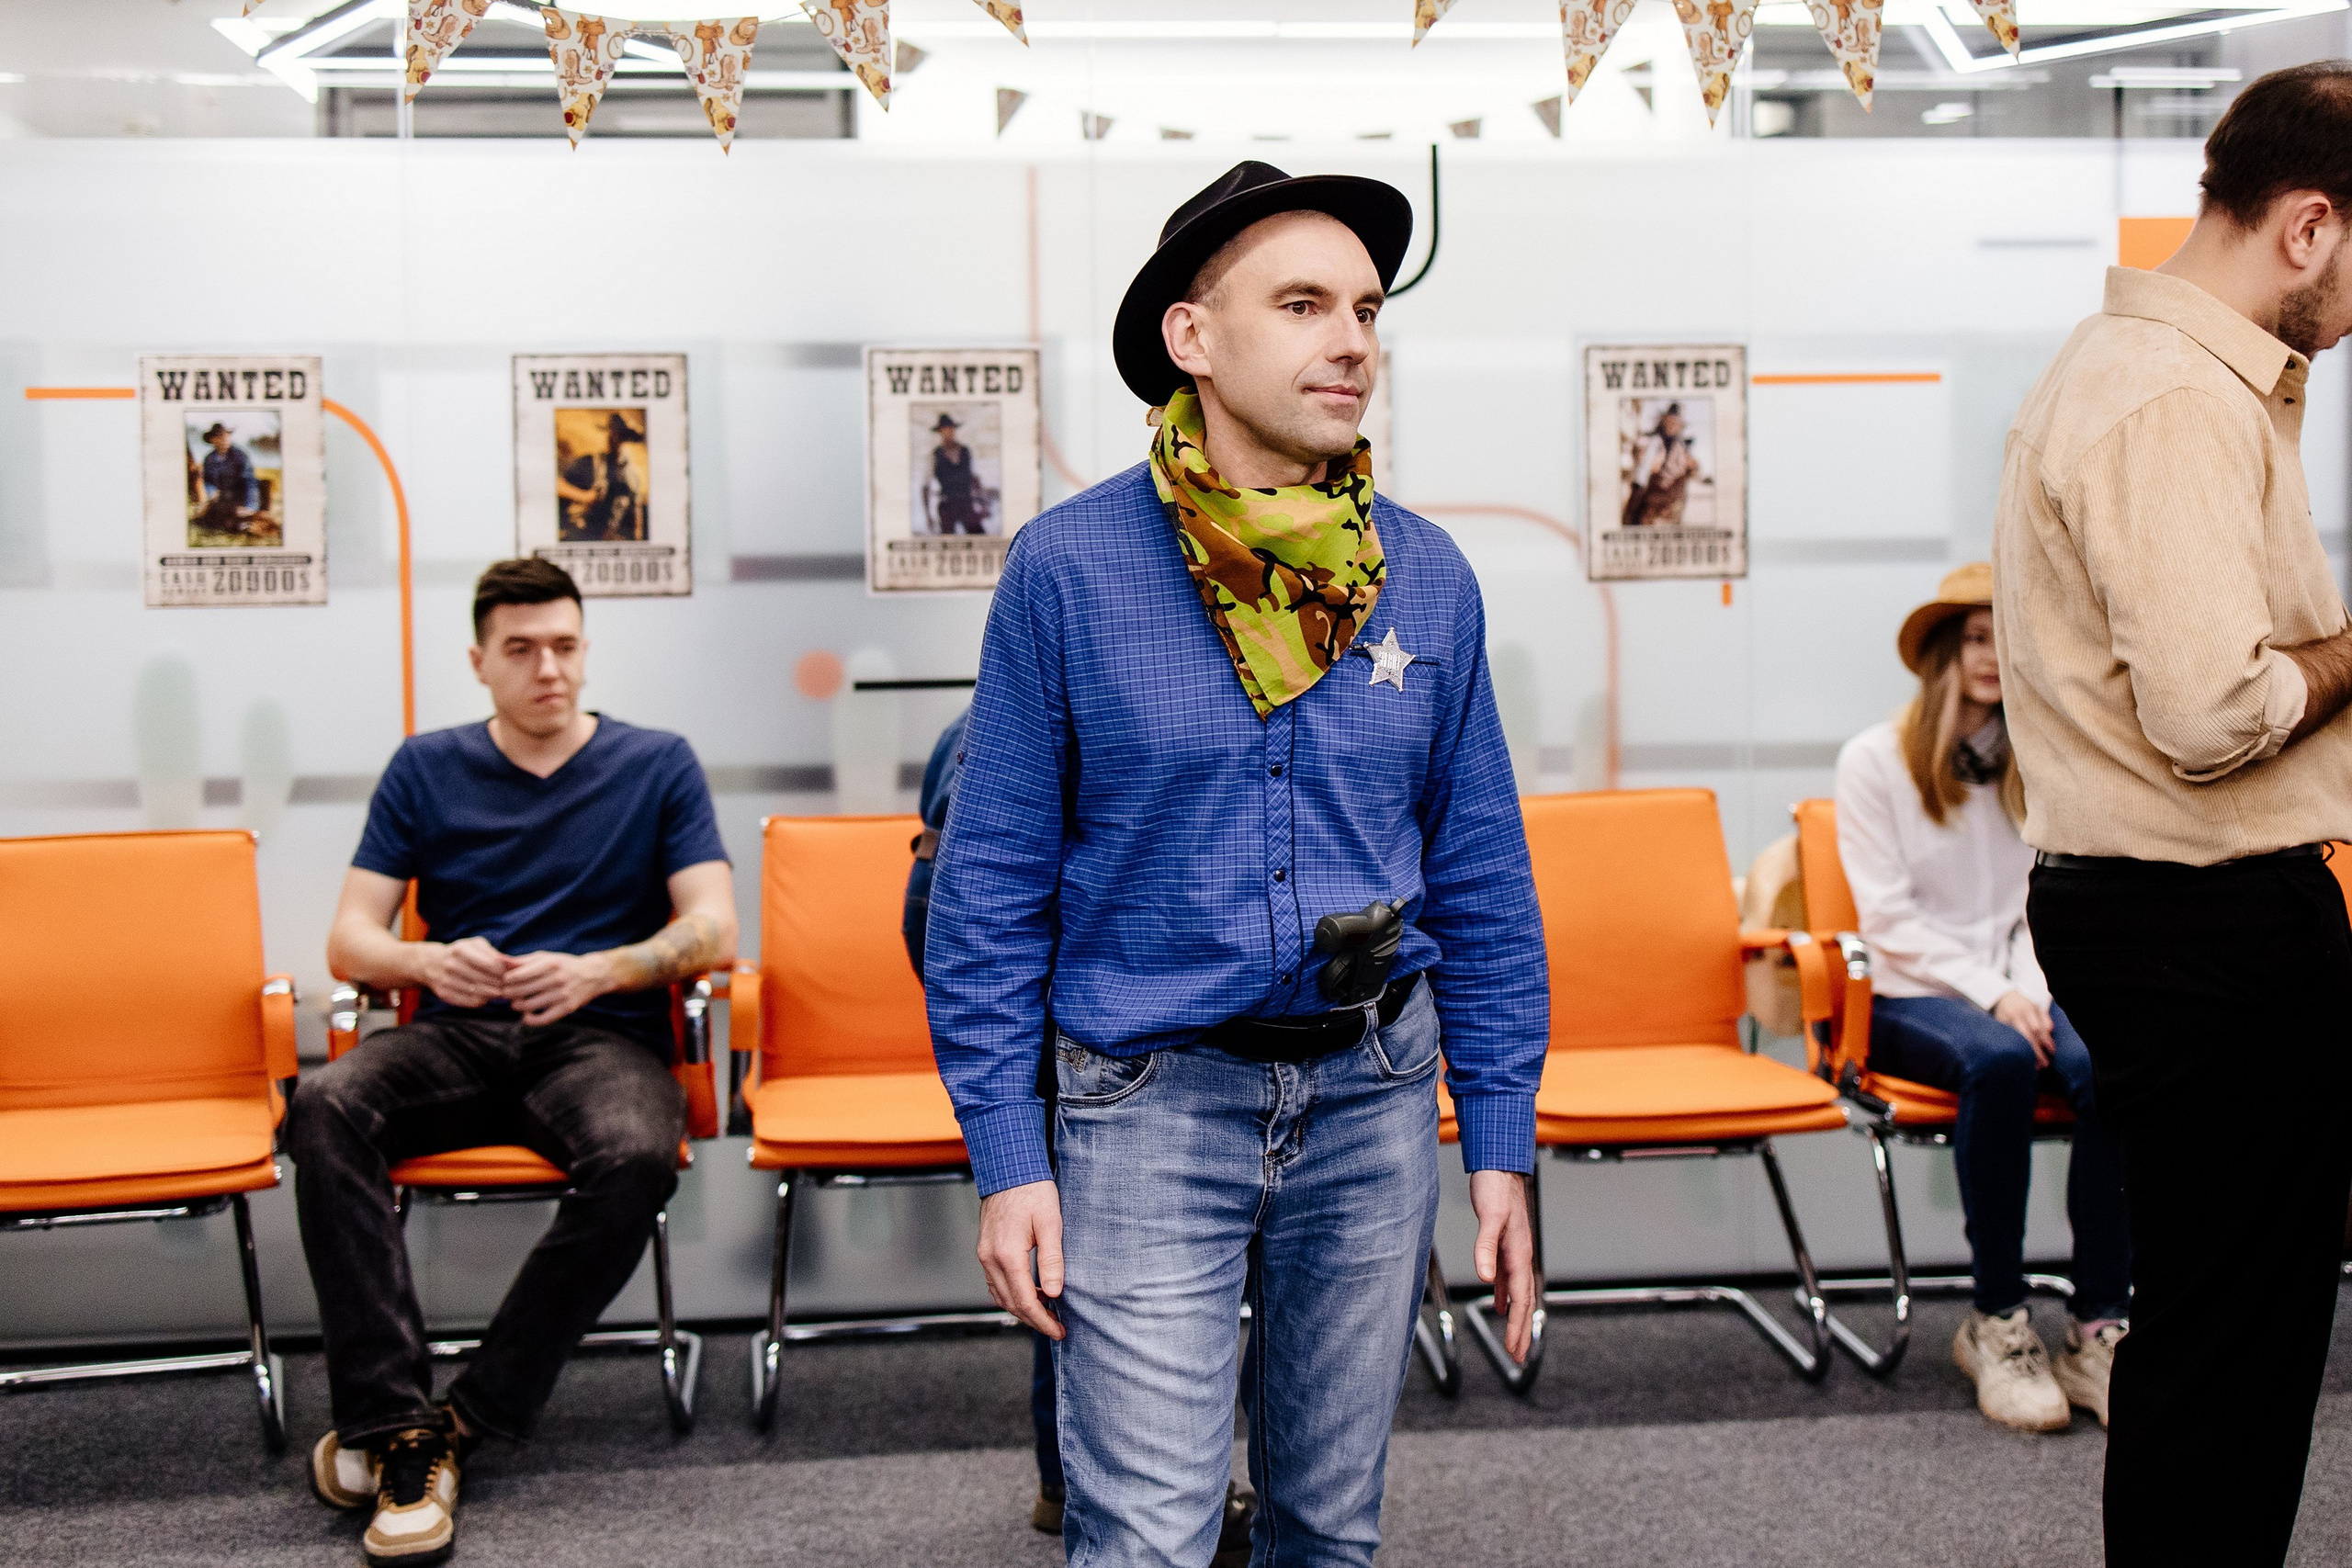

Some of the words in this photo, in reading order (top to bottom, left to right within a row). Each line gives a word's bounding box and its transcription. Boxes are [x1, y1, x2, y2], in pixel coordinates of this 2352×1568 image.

[157, 371, 307, 400] WANTED
[529, 370, 672, 399] WANTED
[886, 366, 1023, 394] WANTED
[1600, 360, 1731, 389] WANTED
